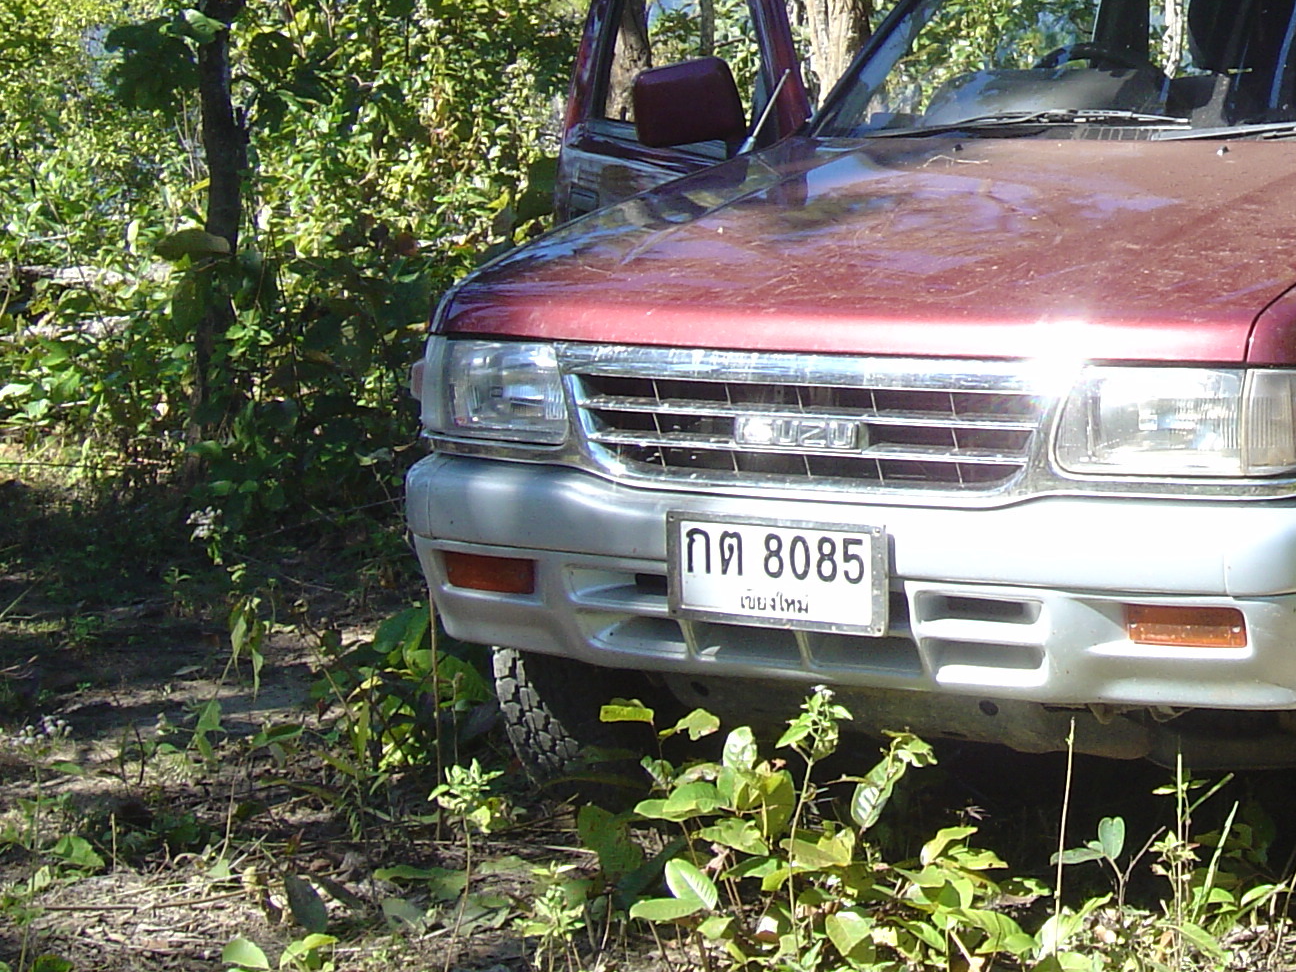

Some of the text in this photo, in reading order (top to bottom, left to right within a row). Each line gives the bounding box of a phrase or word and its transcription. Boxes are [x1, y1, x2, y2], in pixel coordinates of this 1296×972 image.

[736, 416, 858, 449] IUZU
[686, 527, 865, 585] กต 8085
